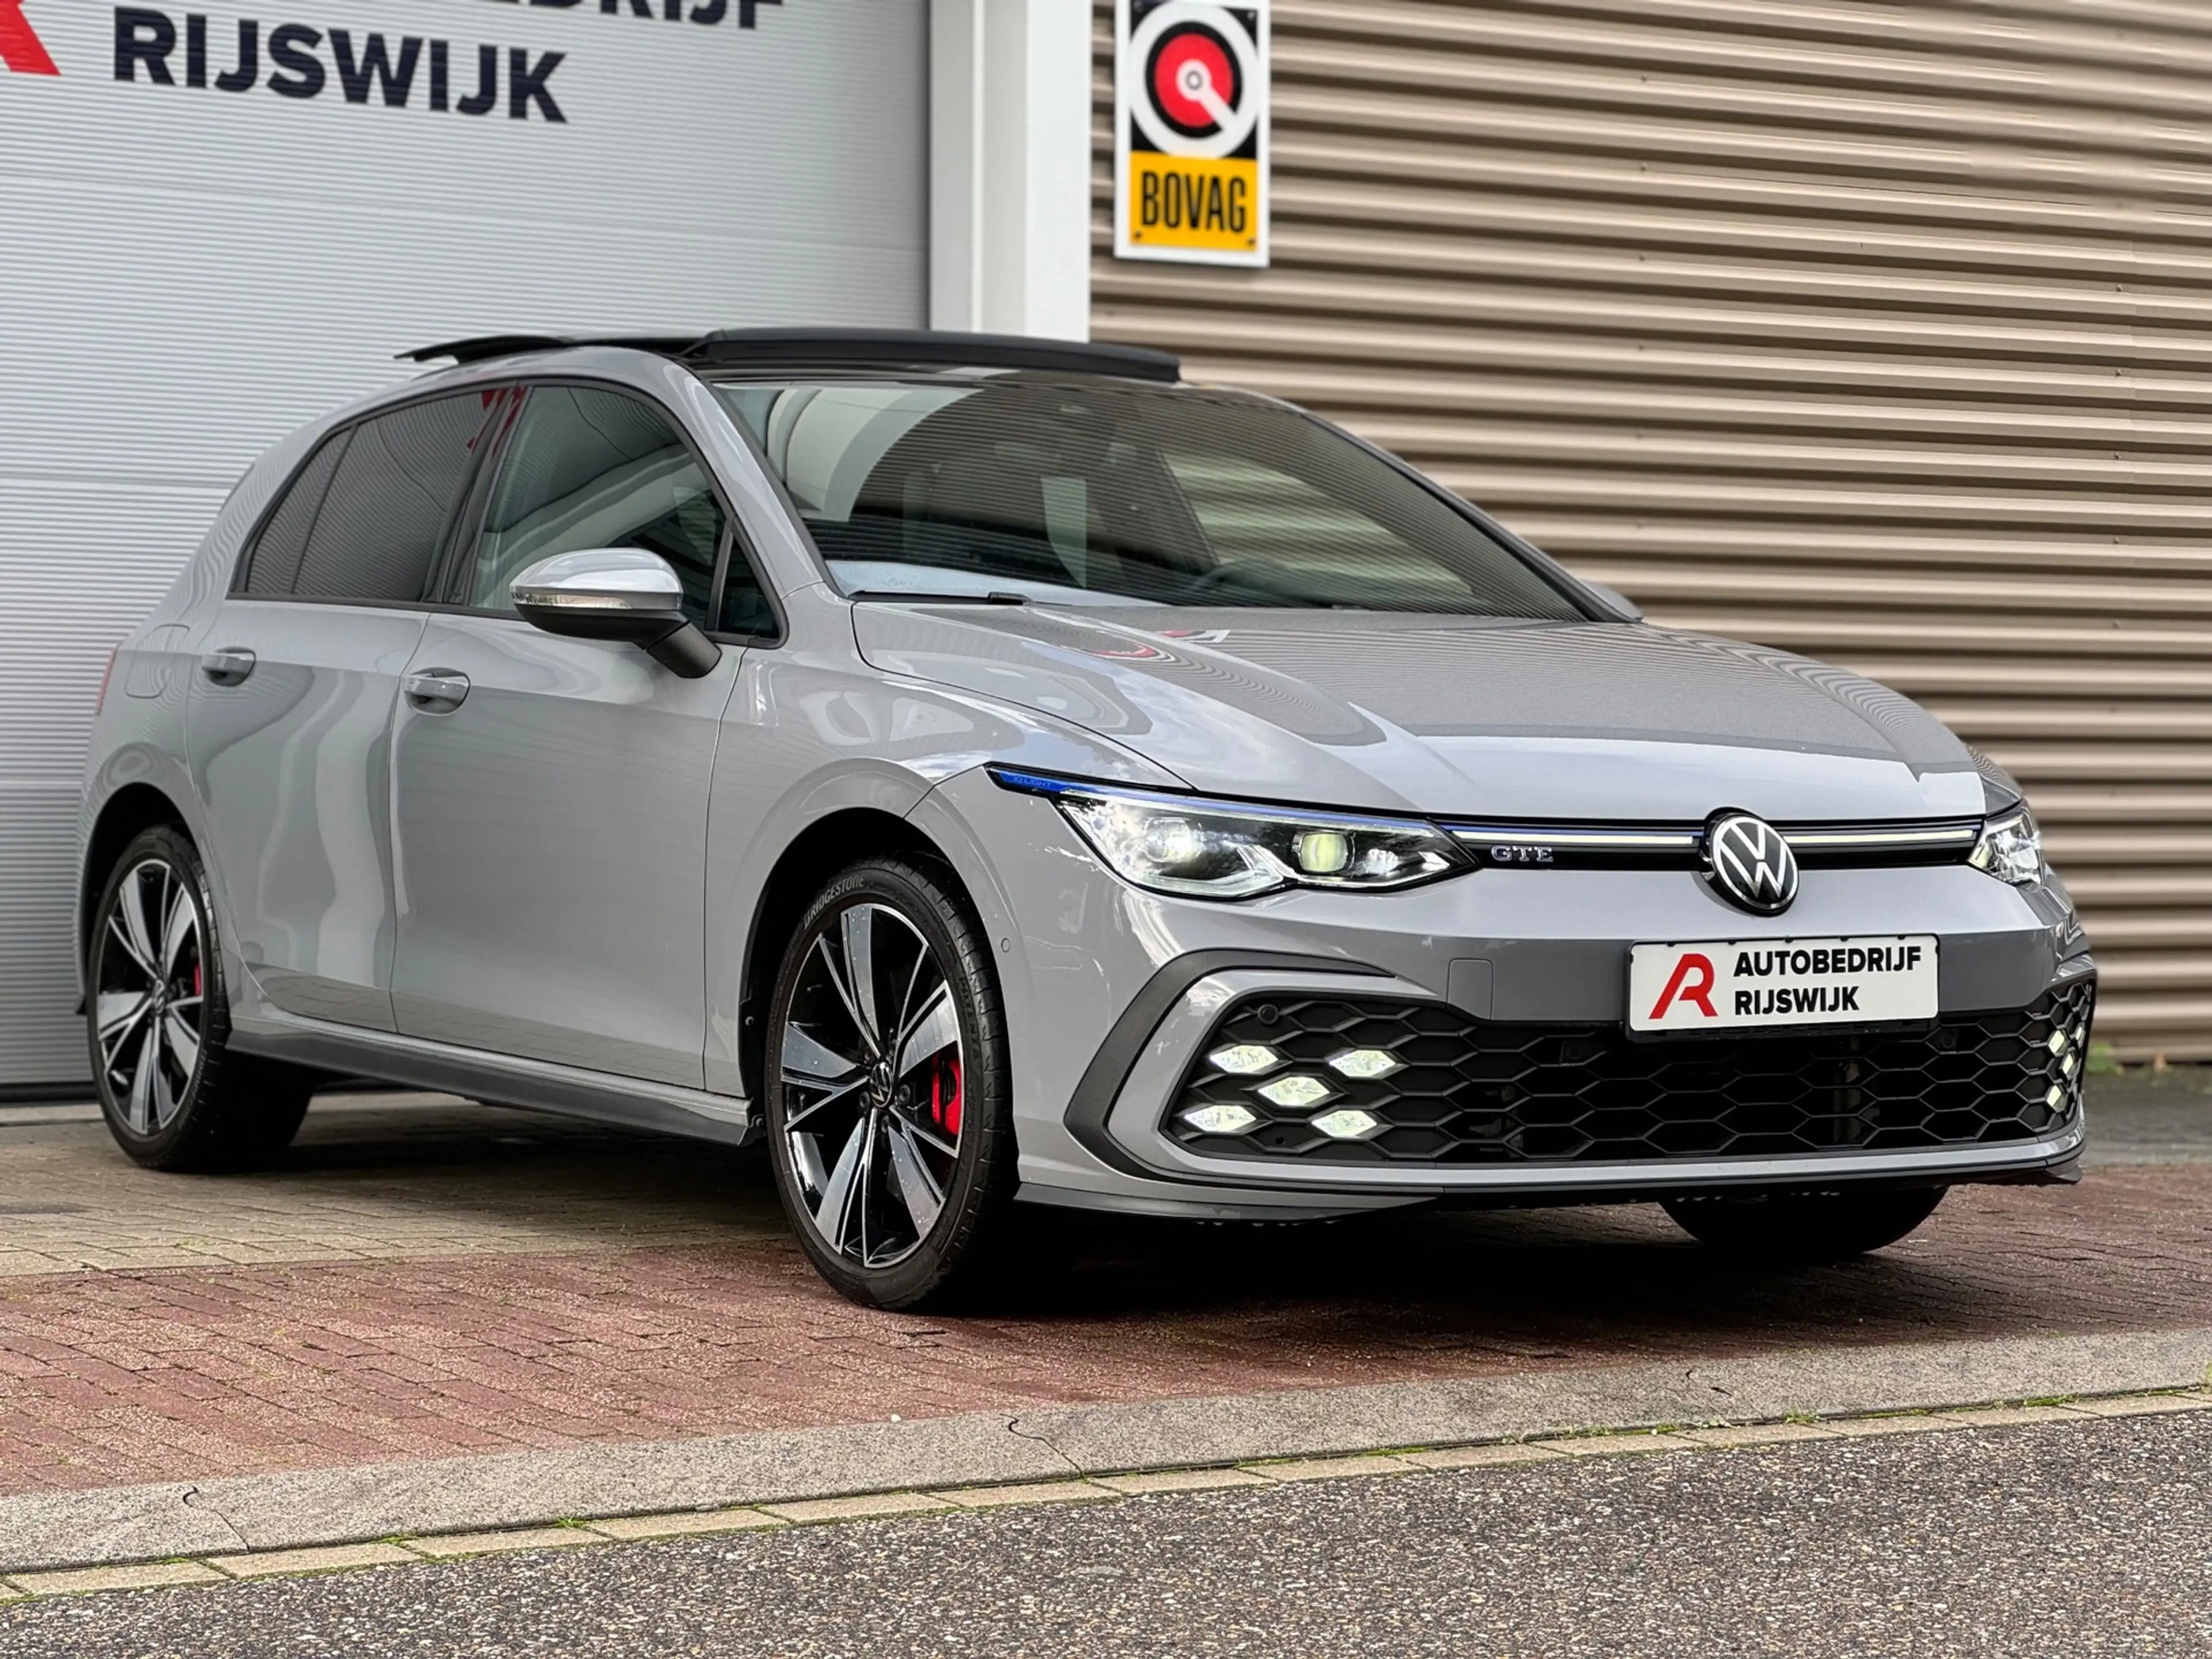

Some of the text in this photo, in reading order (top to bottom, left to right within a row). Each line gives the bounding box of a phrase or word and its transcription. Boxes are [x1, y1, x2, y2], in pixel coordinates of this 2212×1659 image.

[115, 5, 568, 123] RIJSWIJK
[1142, 171, 1247, 233] BOVAG
[1491, 845, 1554, 862] GTE
[1733, 946, 1922, 977] AUTOBEDRIJF
[1734, 986, 1860, 1016] RIJSWIJK
